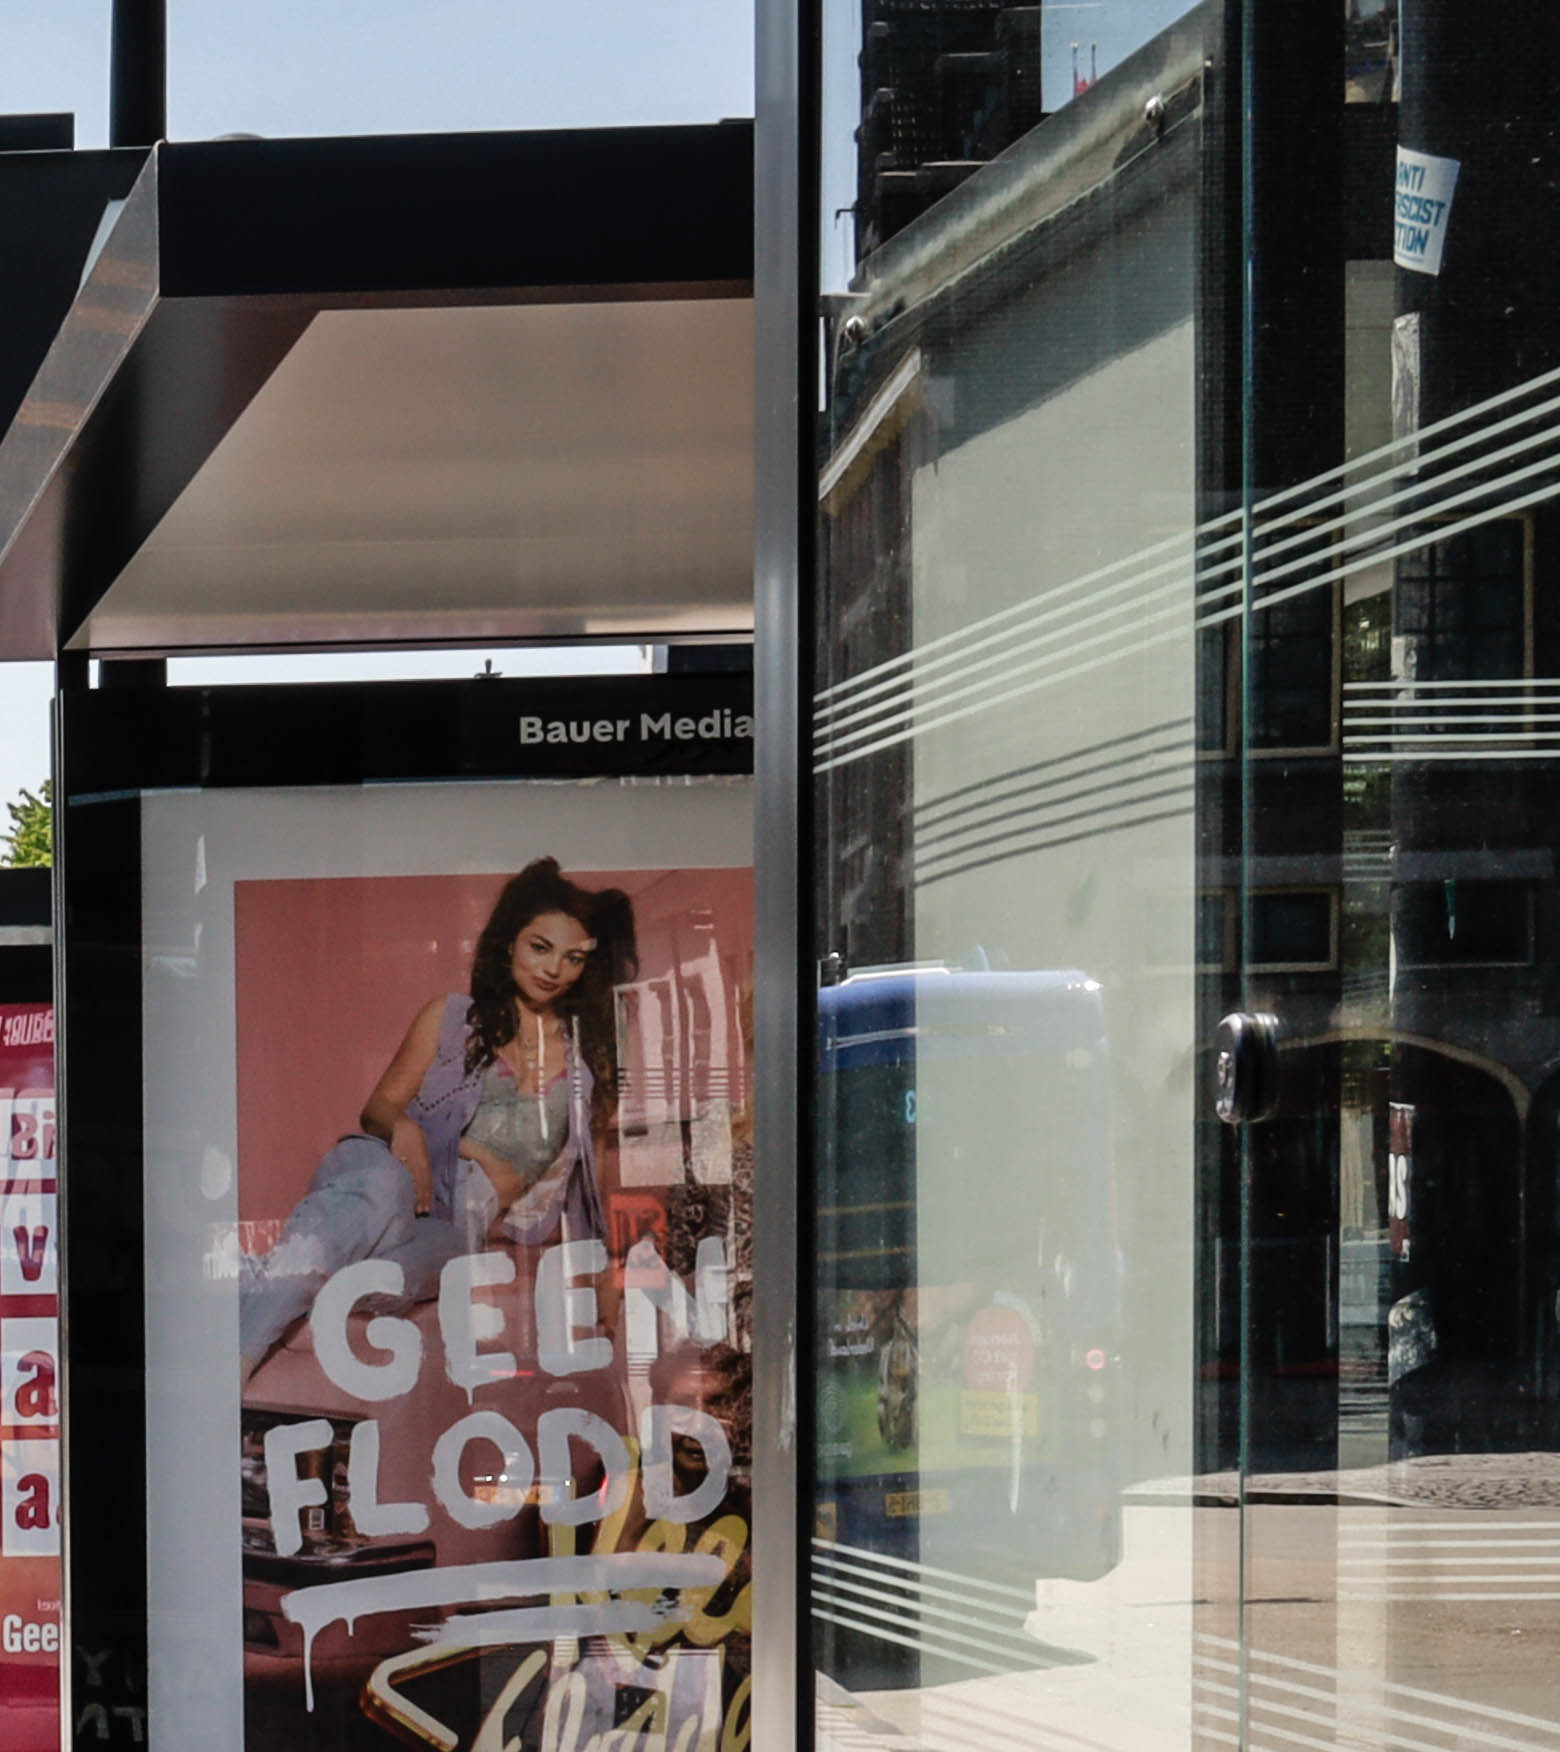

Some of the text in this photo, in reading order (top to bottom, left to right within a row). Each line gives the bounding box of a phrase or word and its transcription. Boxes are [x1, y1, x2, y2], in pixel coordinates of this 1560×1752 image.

[519, 707, 755, 745] Bauer Media
[309, 1235, 730, 1406] GEEN
[263, 1403, 733, 1560] FLODD
[2, 1613, 60, 1653] Gee
